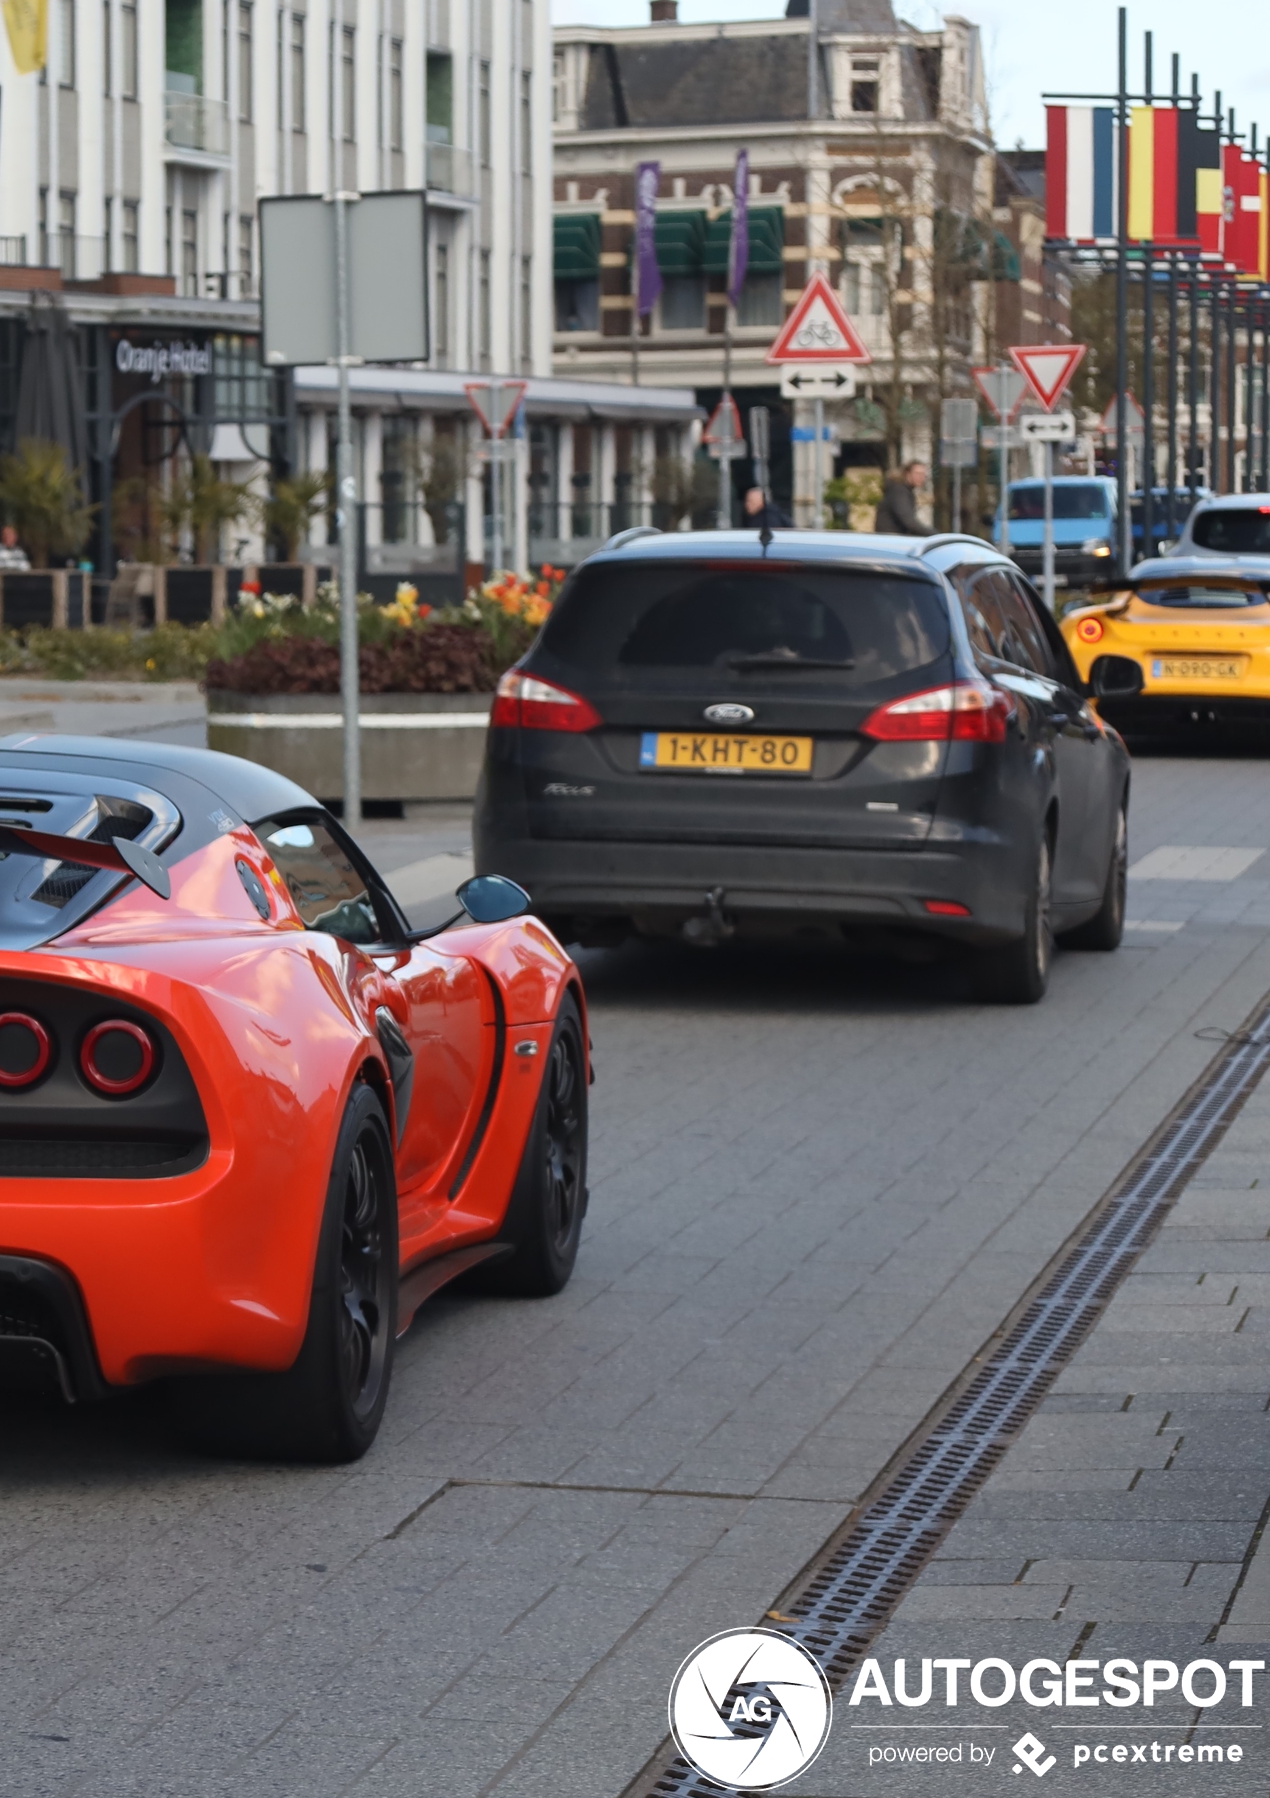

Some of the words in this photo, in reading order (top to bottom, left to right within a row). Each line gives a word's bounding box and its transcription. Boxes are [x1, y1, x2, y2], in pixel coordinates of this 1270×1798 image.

[116, 339, 170, 384] Oranje
[170, 340, 213, 375] Hotel
[670, 737, 799, 765] 1-KHT-80
